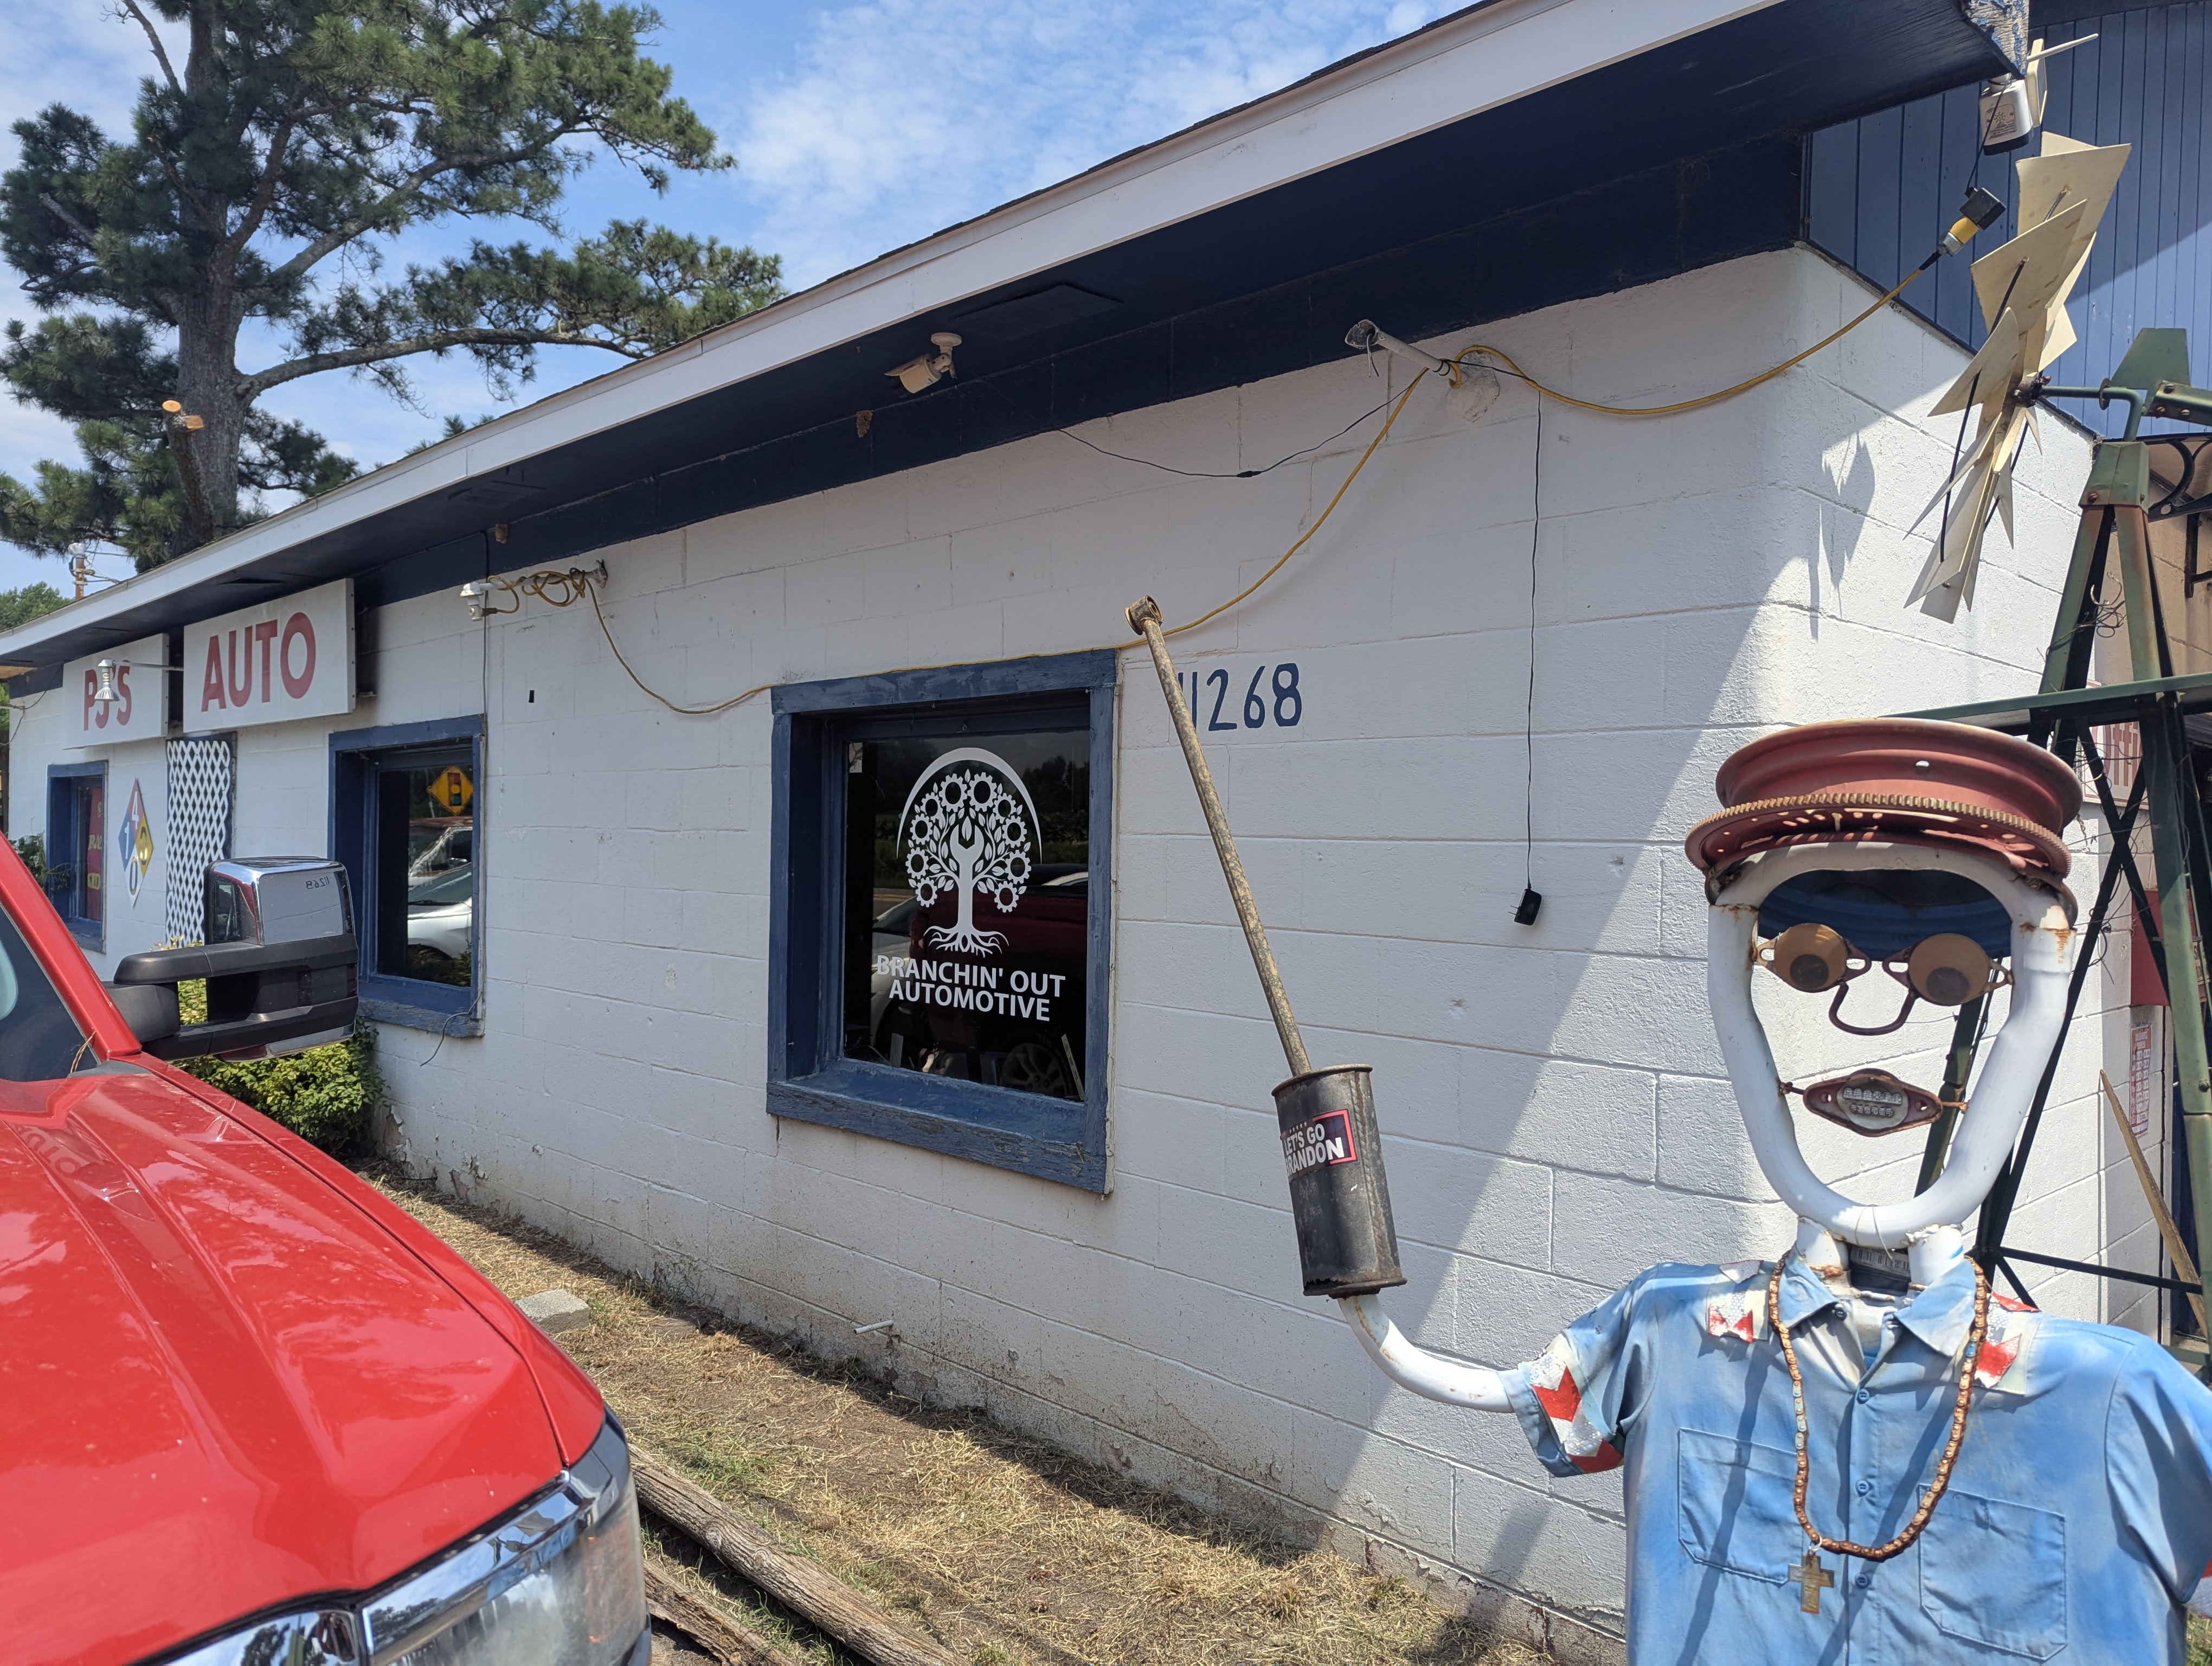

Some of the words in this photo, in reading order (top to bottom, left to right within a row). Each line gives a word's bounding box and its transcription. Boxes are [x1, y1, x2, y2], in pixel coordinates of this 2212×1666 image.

[201, 612, 316, 712] AUTO
[1178, 663, 1302, 731] 1268
[131, 791, 139, 830] 4
[124, 821, 130, 860] 1
[129, 856, 138, 895] 0
[877, 954, 1004, 989] BRANCHIN'
[1010, 970, 1066, 997] OUT
[889, 979, 1050, 1022] AUTOMOTIVE
[1284, 1131, 1305, 1156] LET'S
[1306, 1123, 1325, 1144] GO
